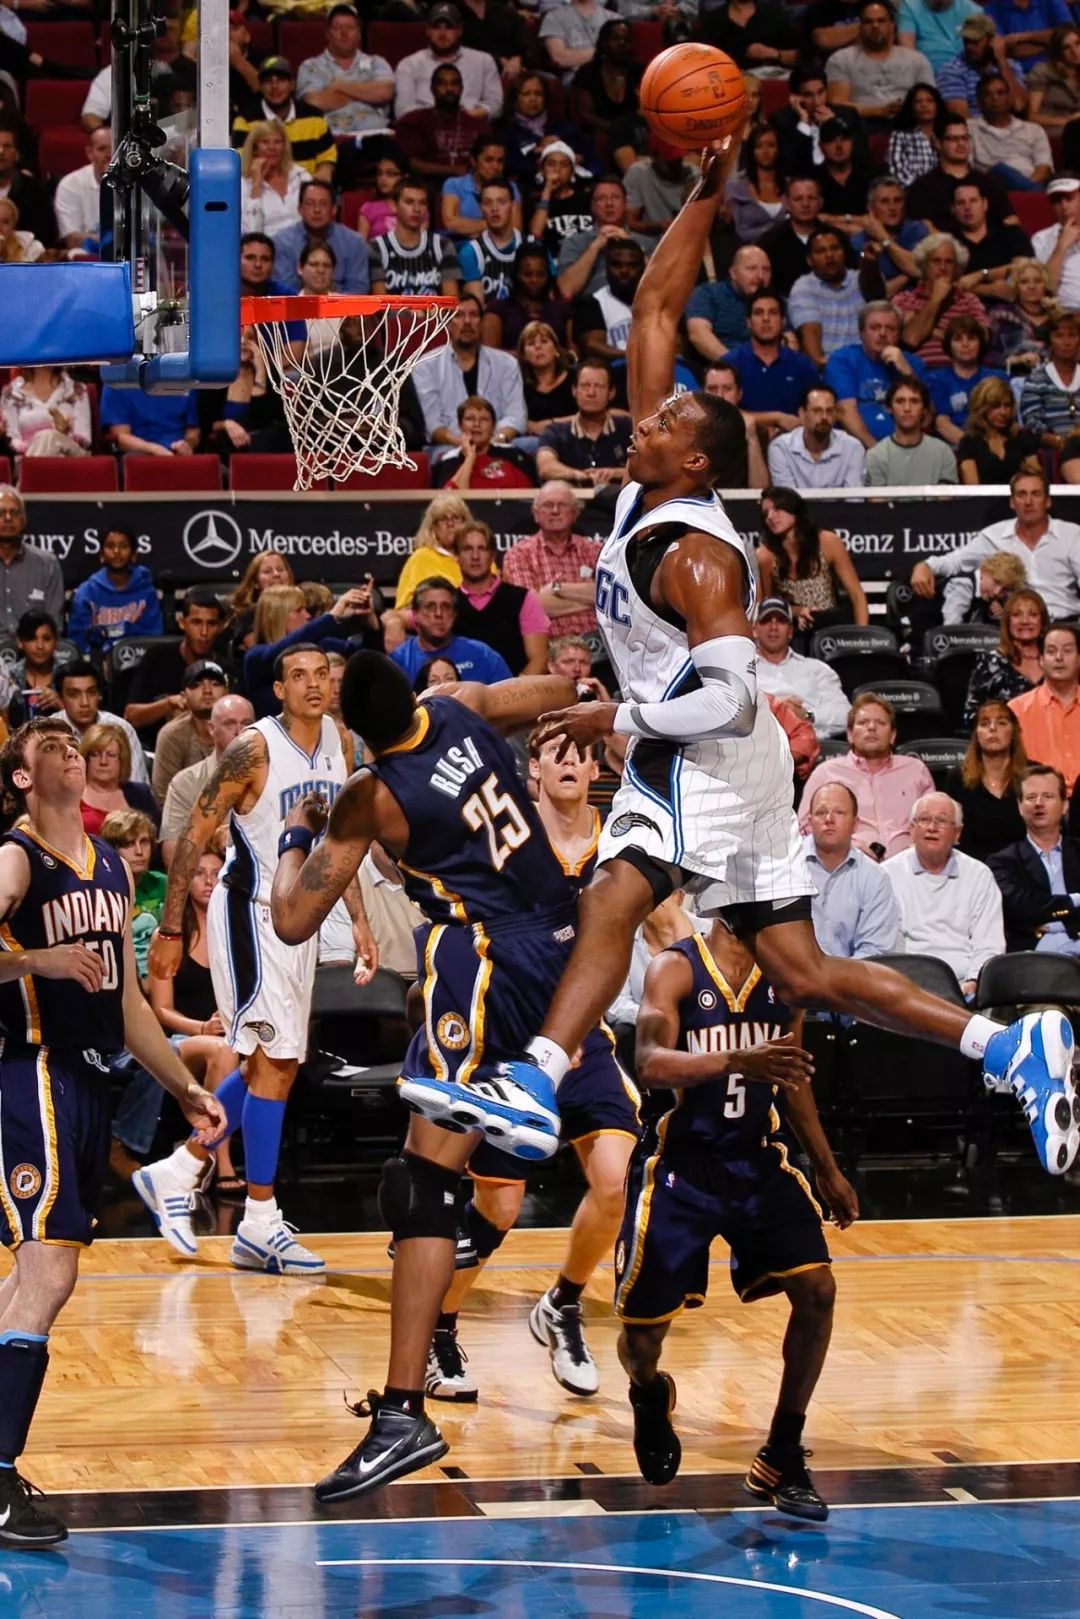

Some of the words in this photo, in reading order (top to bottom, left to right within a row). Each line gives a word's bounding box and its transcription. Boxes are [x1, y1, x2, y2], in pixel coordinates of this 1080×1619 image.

[547, 214, 594, 233] UKE
[248, 528, 418, 556] Mercedes-Be
[903, 528, 981, 553] Luxur
[429, 736, 485, 800] RUSH
[921, 752, 966, 763] Mercedes-Be
[460, 771, 531, 873] 25
[723, 1072, 747, 1119] 5
